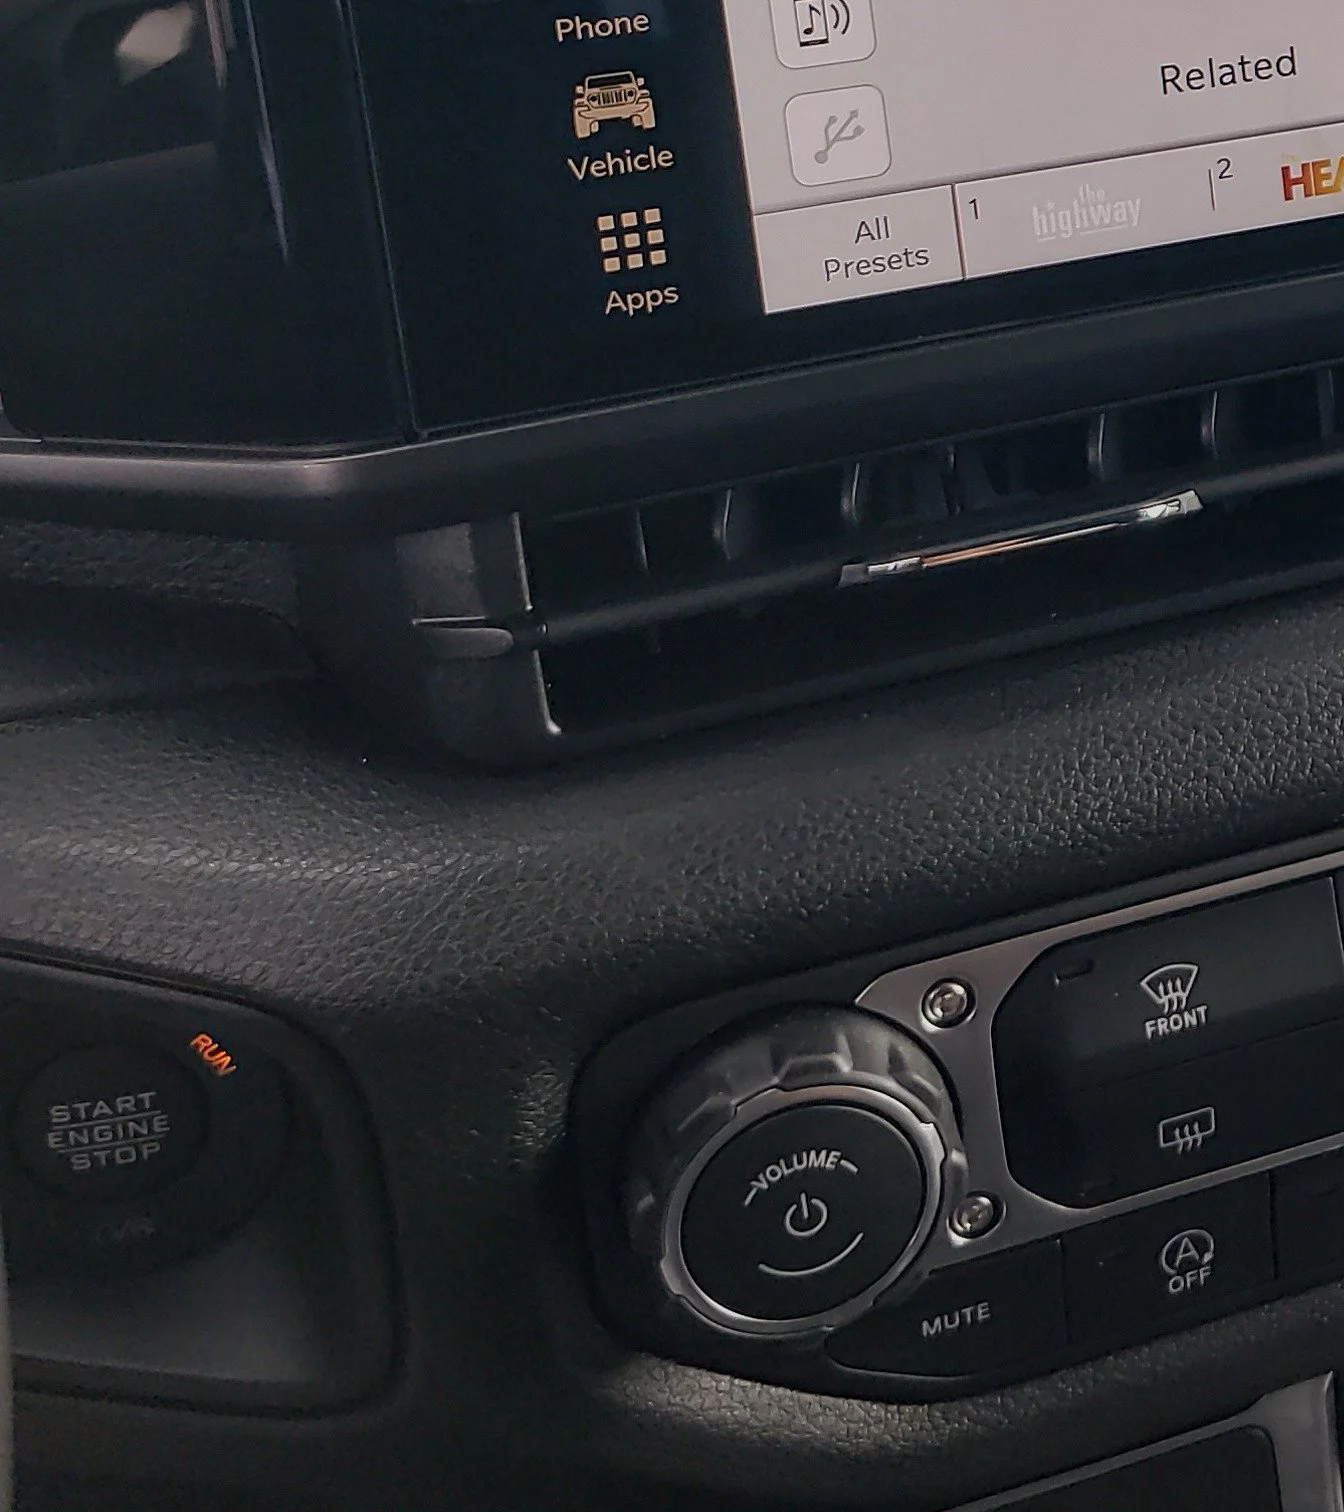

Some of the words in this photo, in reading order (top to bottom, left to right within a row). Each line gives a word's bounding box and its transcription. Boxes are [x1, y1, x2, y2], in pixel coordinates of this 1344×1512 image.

[554, 12, 650, 43] Phone
[1160, 46, 1298, 95] Related
[567, 146, 675, 180] Vehicle
[1217, 158, 1234, 180] 2
[969, 198, 979, 220] 1
[1033, 197, 1141, 238] highway
[853, 216, 892, 244] All
[823, 244, 930, 282] Presets
[605, 283, 679, 316] Apps
[1144, 1005, 1208, 1039] FRONT
[189, 1033, 237, 1078] RUN
[49, 1091, 157, 1124] START
[47, 1113, 171, 1150] ENGINE
[69, 1141, 161, 1172] STOP
[749, 1149, 842, 1191] VOLUME
[1168, 1266, 1211, 1293] OFF
[921, 1301, 992, 1339] MUTE
